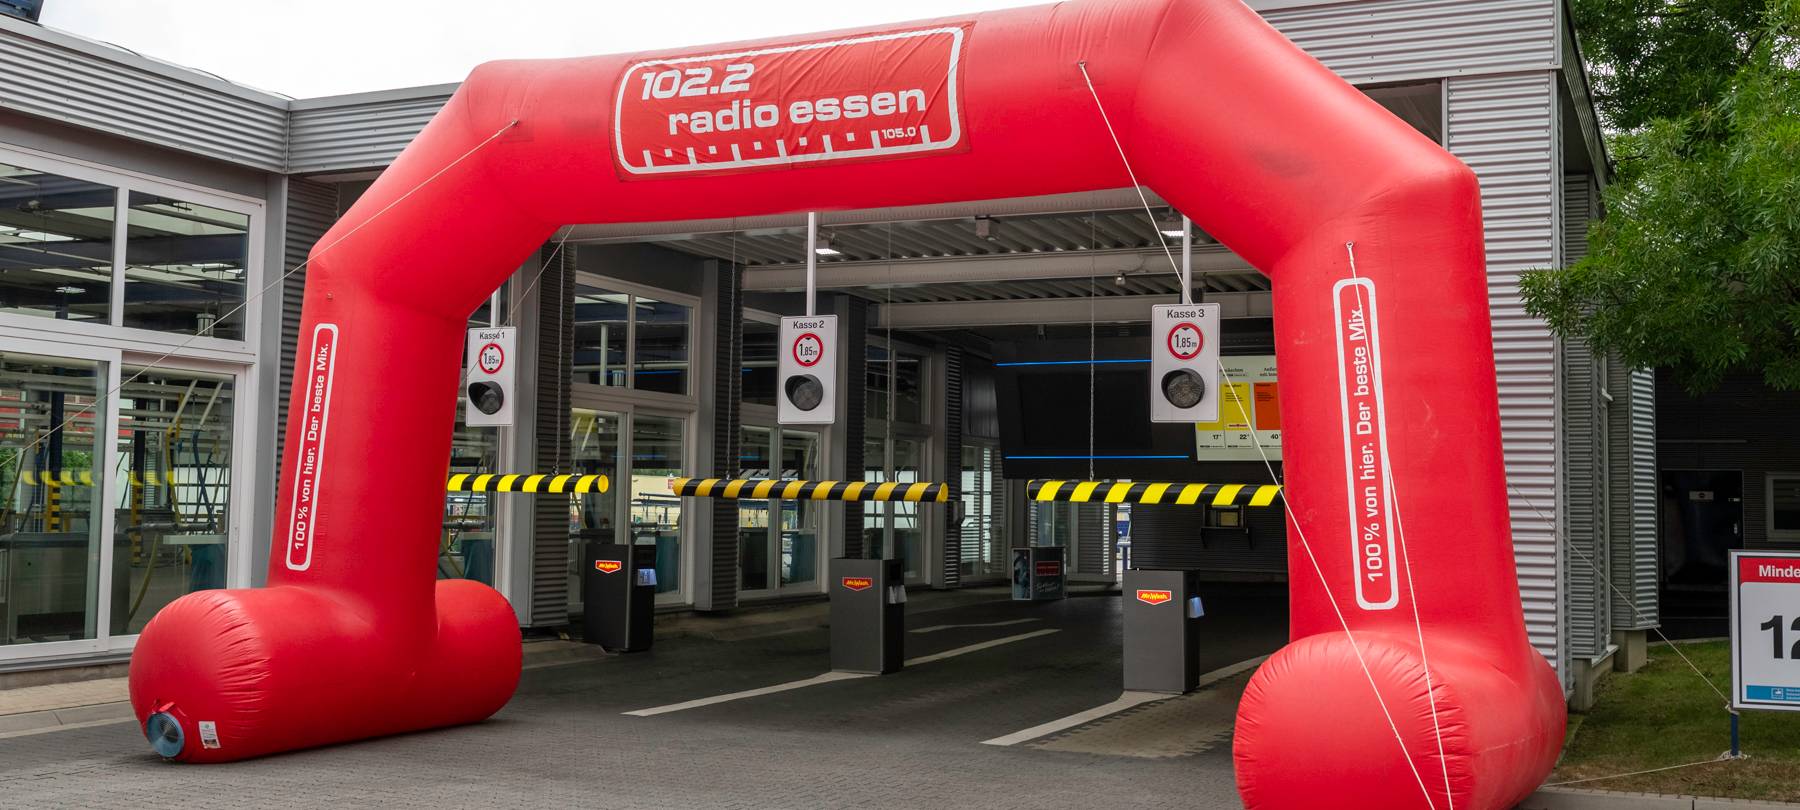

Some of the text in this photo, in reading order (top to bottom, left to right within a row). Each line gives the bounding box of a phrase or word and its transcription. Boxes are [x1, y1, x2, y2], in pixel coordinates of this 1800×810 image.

[641, 63, 755, 101] 102.2
[668, 88, 927, 135] radio essen
[881, 126, 917, 140] 105.0
[793, 320, 825, 329] Kasse 2
[1167, 308, 1205, 319] Kasse 3
[1349, 304, 1366, 341] Mix.
[479, 332, 501, 340] Kasse
[316, 343, 329, 371] Mix.
[1354, 346, 1370, 397] beste
[311, 375, 325, 412] beste
[307, 416, 319, 441] Der
[1356, 402, 1373, 435] Der
[303, 447, 316, 475] hier.
[1360, 442, 1376, 481] hier.
[301, 479, 312, 503] von
[1366, 486, 1379, 518] von
